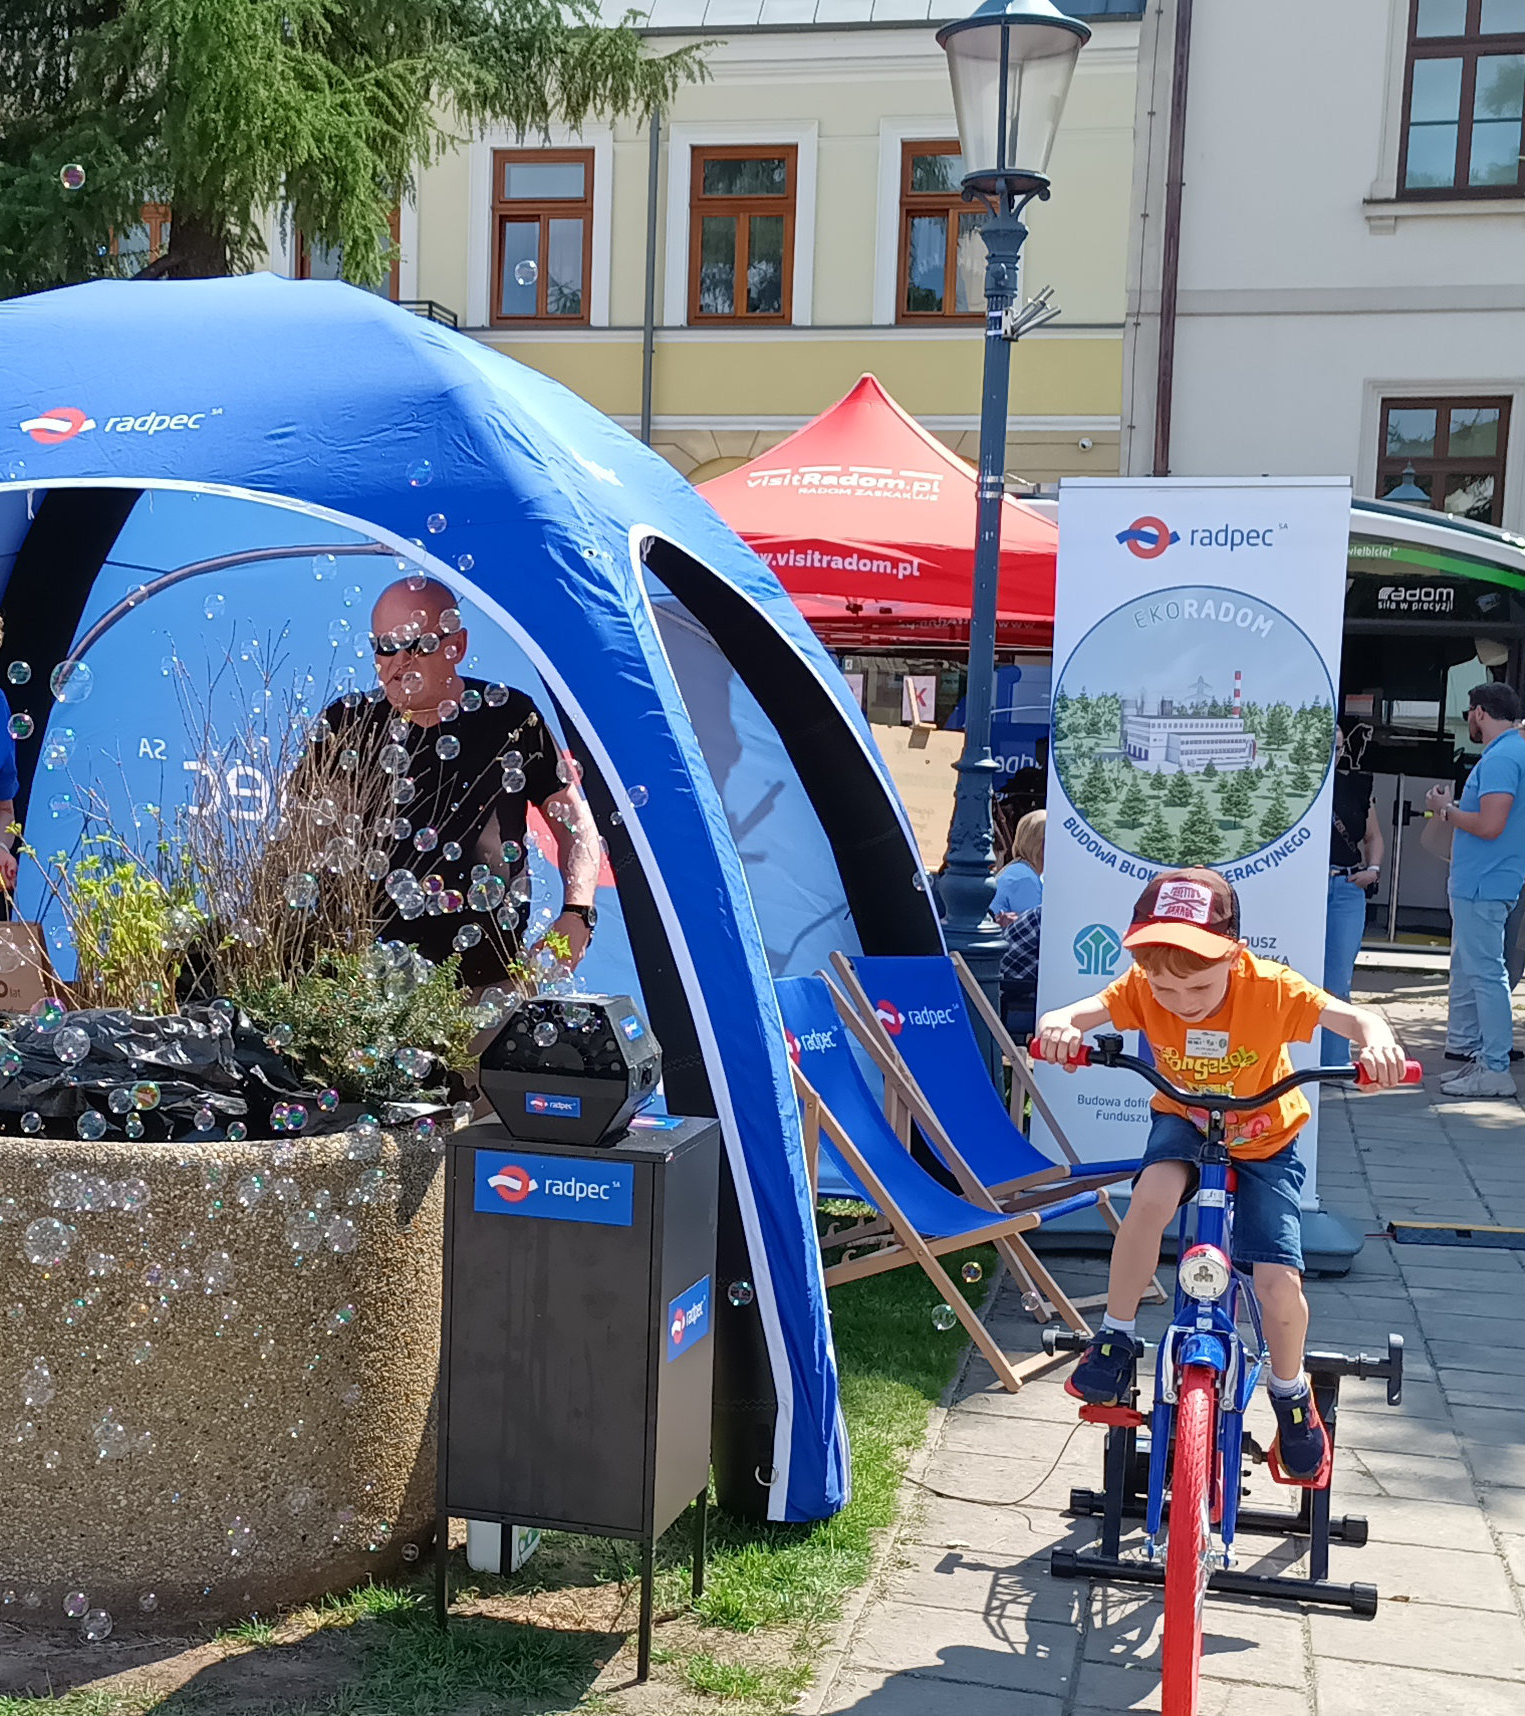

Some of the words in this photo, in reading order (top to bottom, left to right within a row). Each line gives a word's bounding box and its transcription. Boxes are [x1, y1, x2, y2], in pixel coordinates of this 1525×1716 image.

[104, 411, 206, 436] radpec
[746, 472, 941, 494] visitRadom.pl
[798, 487, 852, 496] RADOM
[1190, 523, 1274, 552] radpec
[755, 549, 920, 579] w.visitradom.pl
[1062, 816, 1119, 869] BUDOWA
[1118, 859, 1163, 885] BLOK
[1220, 826, 1312, 885] ERACYJNEGO
[908, 1005, 956, 1029] radpec
[800, 1028, 837, 1054] radpec
[549, 1101, 573, 1110] radpec
[1077, 1094, 1121, 1107] Budowa
[1096, 1109, 1149, 1123] Funduszu
[545, 1177, 610, 1201] radpec
